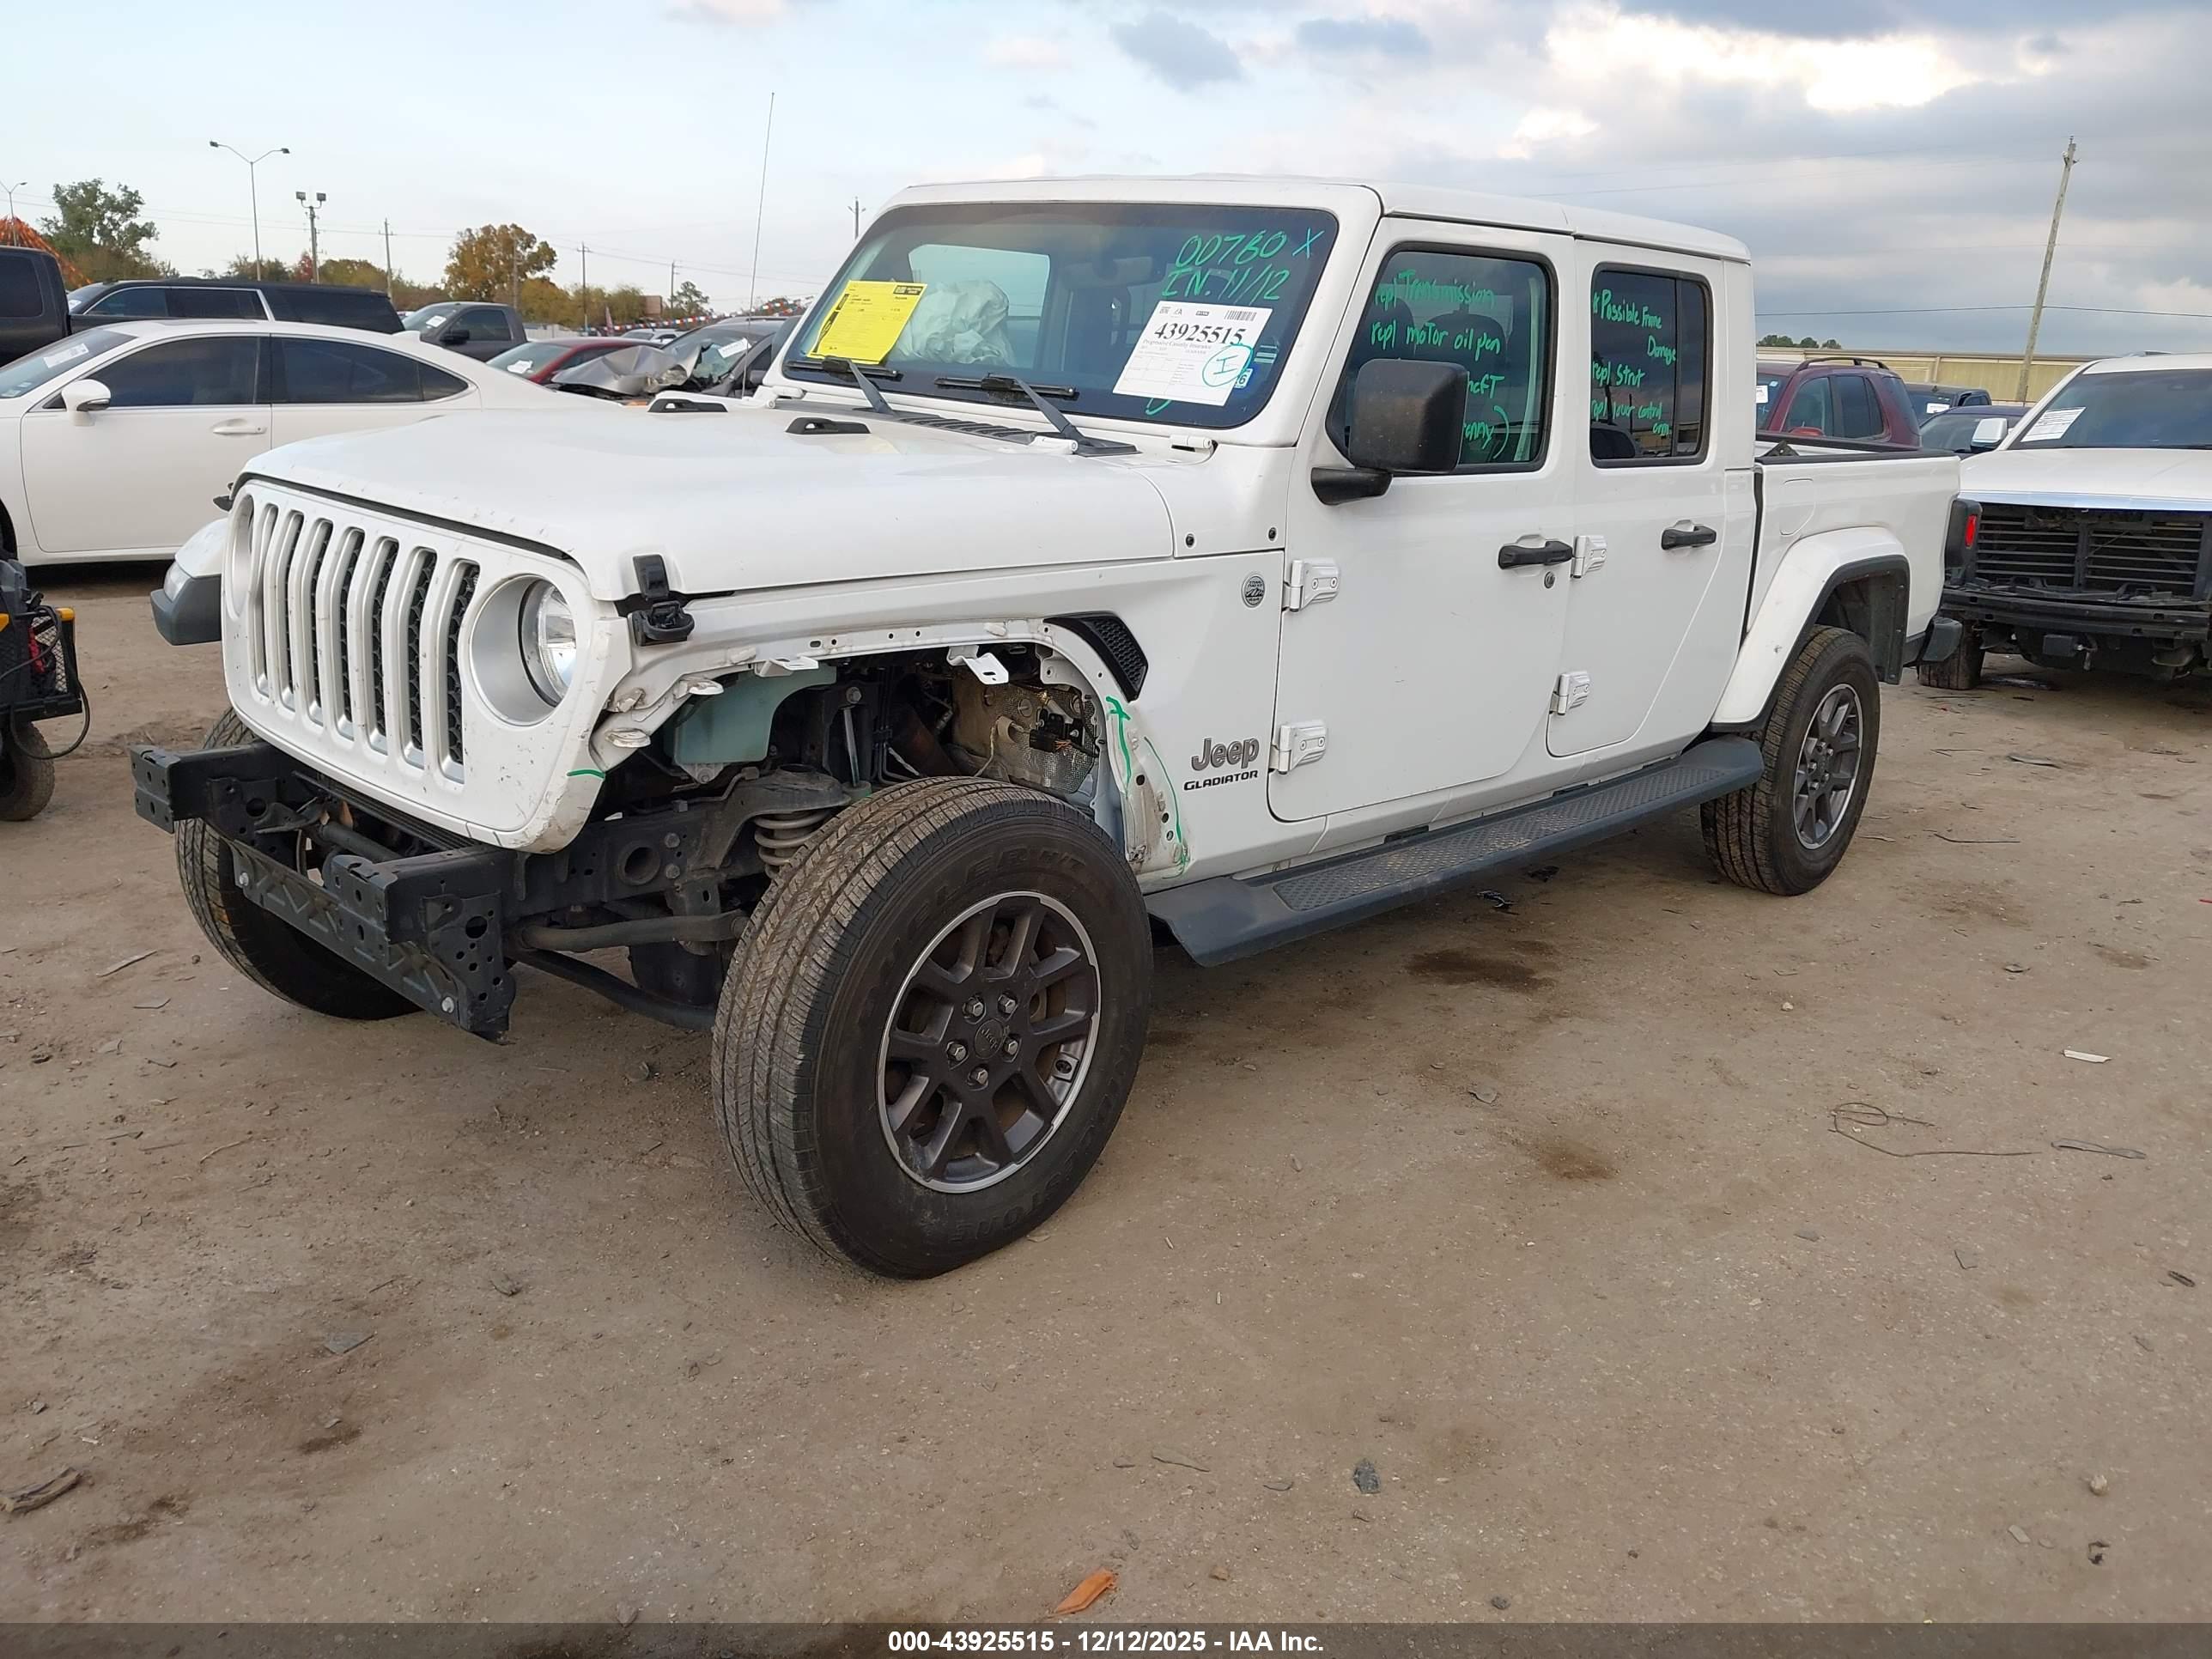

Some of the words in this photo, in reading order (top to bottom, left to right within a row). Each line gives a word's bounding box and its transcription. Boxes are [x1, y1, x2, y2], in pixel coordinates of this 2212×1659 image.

[1601, 289, 1640, 325] Possible
[1154, 322, 1246, 345] 43925515
[1454, 328, 1474, 349] oil
[1191, 738, 1260, 771] Jeep
[1183, 770, 1258, 791] GLADIATOR
